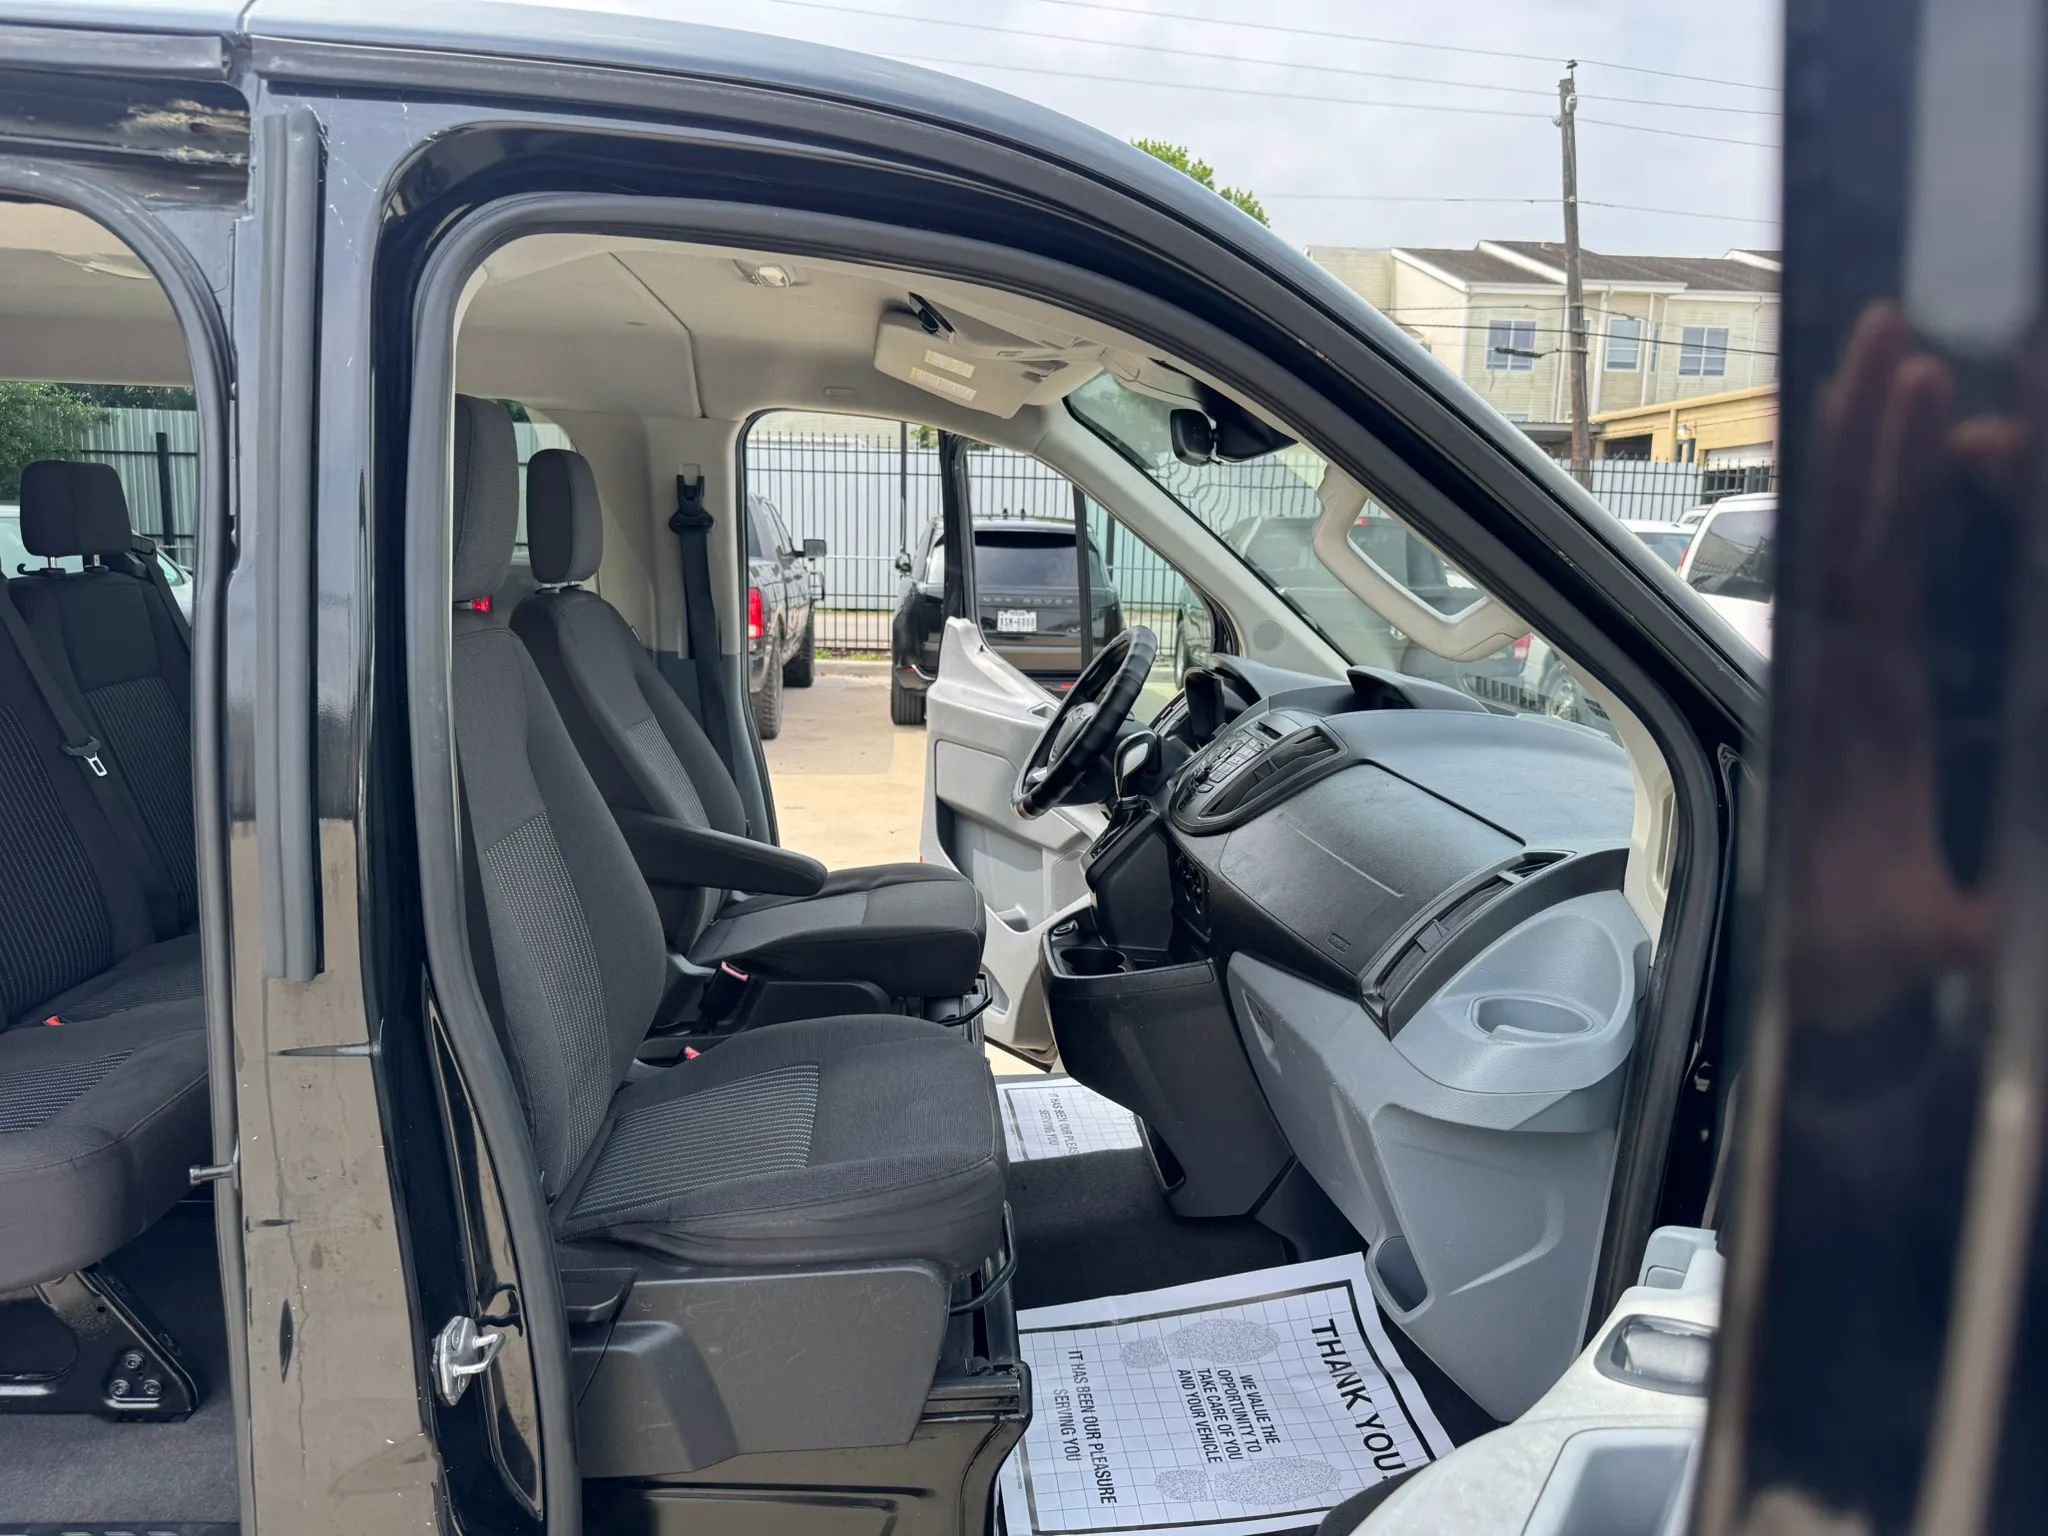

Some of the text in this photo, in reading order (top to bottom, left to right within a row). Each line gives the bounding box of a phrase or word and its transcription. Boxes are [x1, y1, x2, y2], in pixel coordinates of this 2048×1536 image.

[1039, 1109, 1060, 1146] SERVING YOU
[1050, 1098, 1063, 1109] HAS
[1054, 1110, 1068, 1122] BEEN
[1059, 1123, 1073, 1135] OUR
[1311, 1318, 1373, 1411] THANK
[1053, 1388, 1082, 1462] SERVING YOU
[1068, 1350, 1117, 1504] IT HAS BEEN OUR PLEASURE
[1177, 1369, 1223, 1464] AND YOUR VEHICLE
[1197, 1368, 1244, 1460] TAKE CARE OF YOU
[1217, 1369, 1262, 1453] OPPORTUNITY TO
[1240, 1374, 1280, 1444] WE VALUE THE
